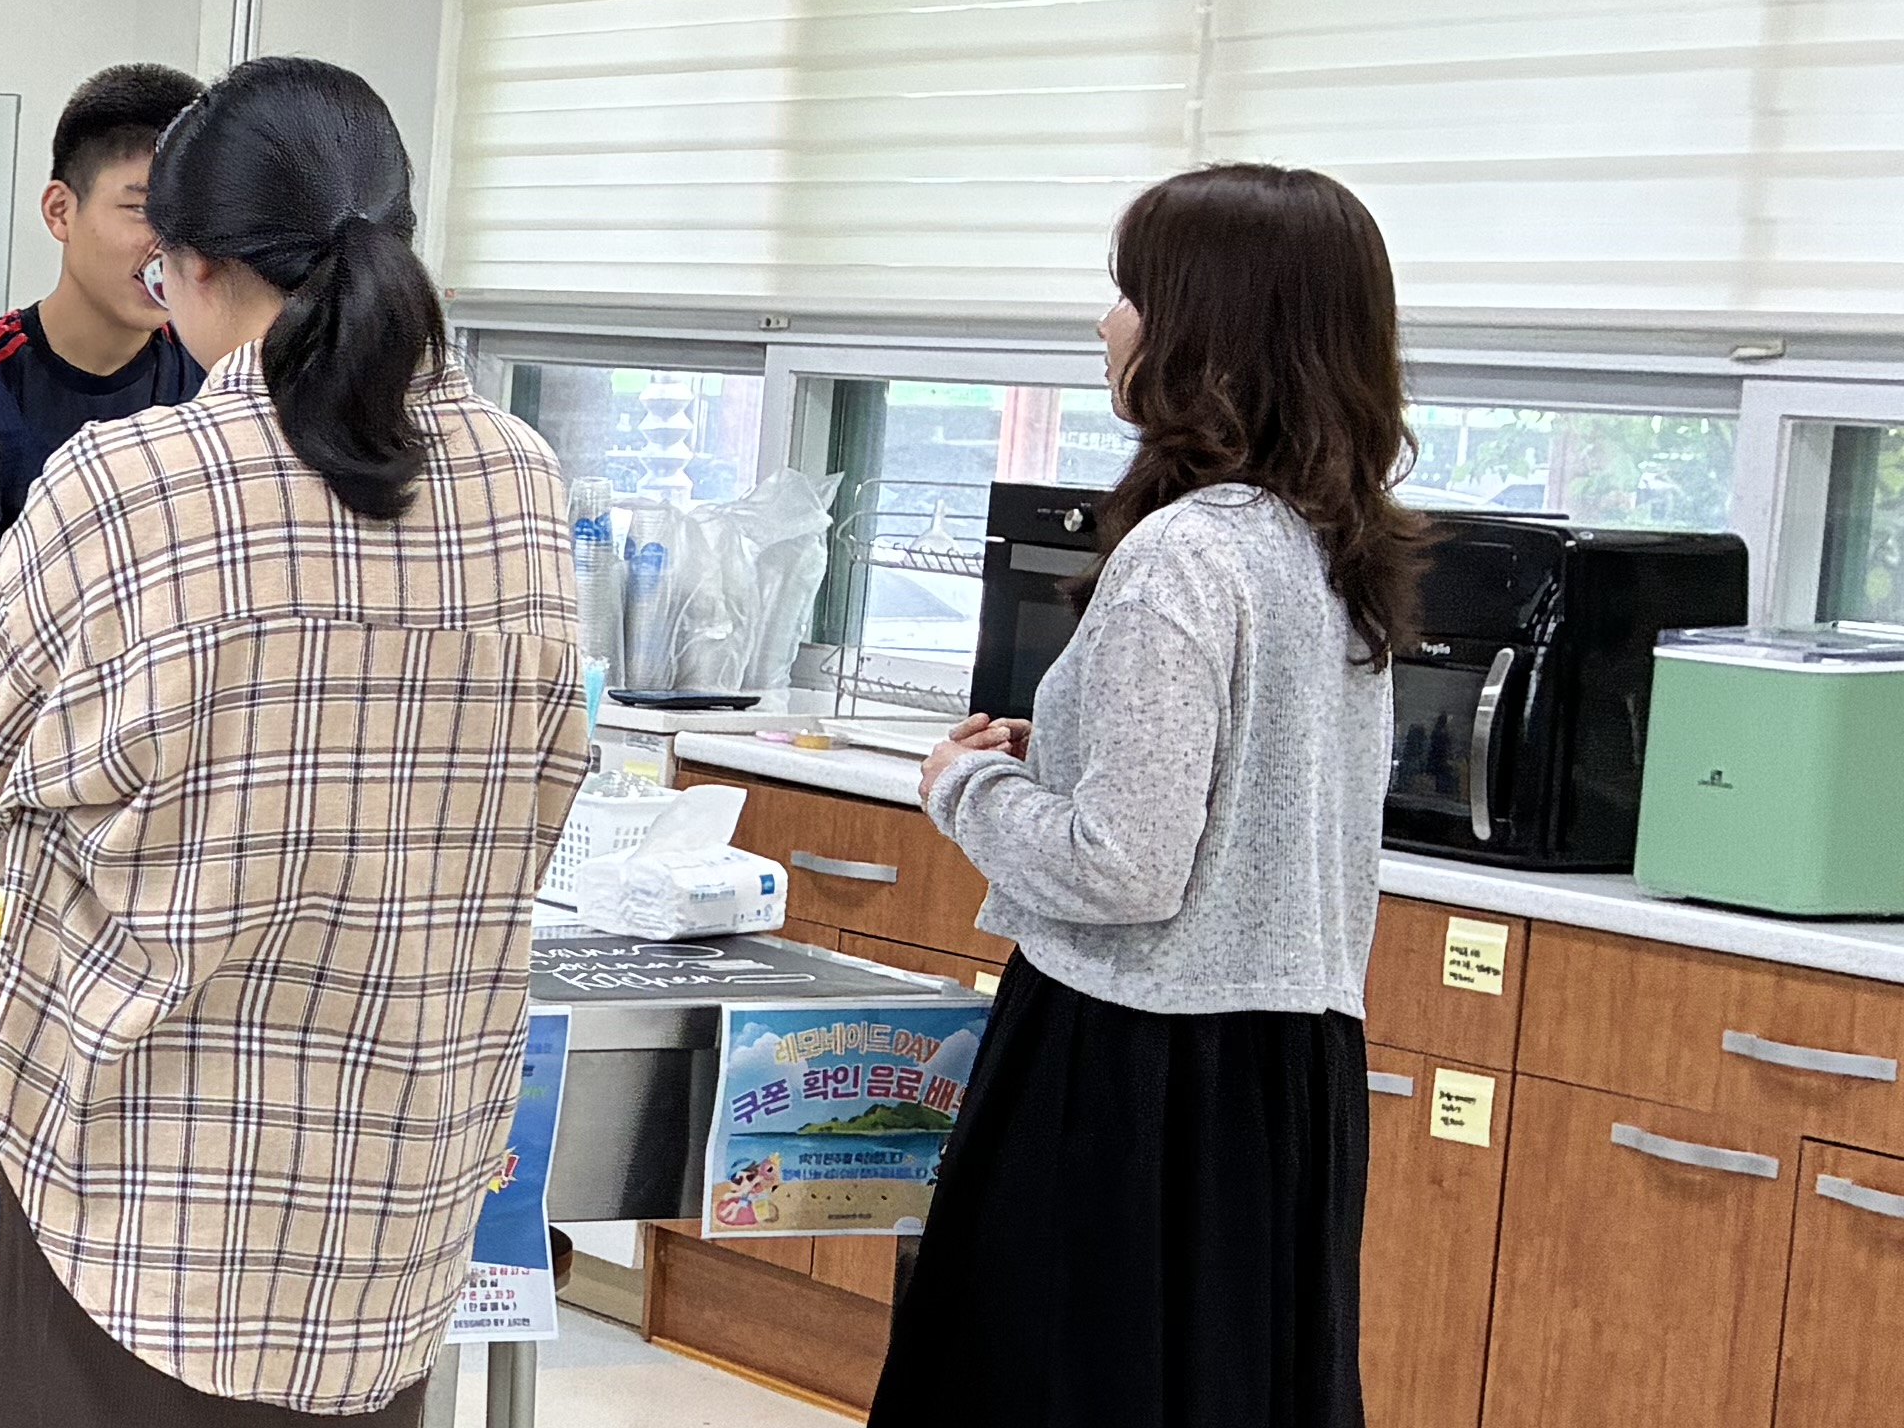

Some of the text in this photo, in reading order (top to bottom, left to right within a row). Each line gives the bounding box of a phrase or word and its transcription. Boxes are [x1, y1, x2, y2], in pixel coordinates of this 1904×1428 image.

[731, 1079, 790, 1124] 쿠폰
[802, 1065, 862, 1100] 확인
[867, 1065, 924, 1102] 음료
